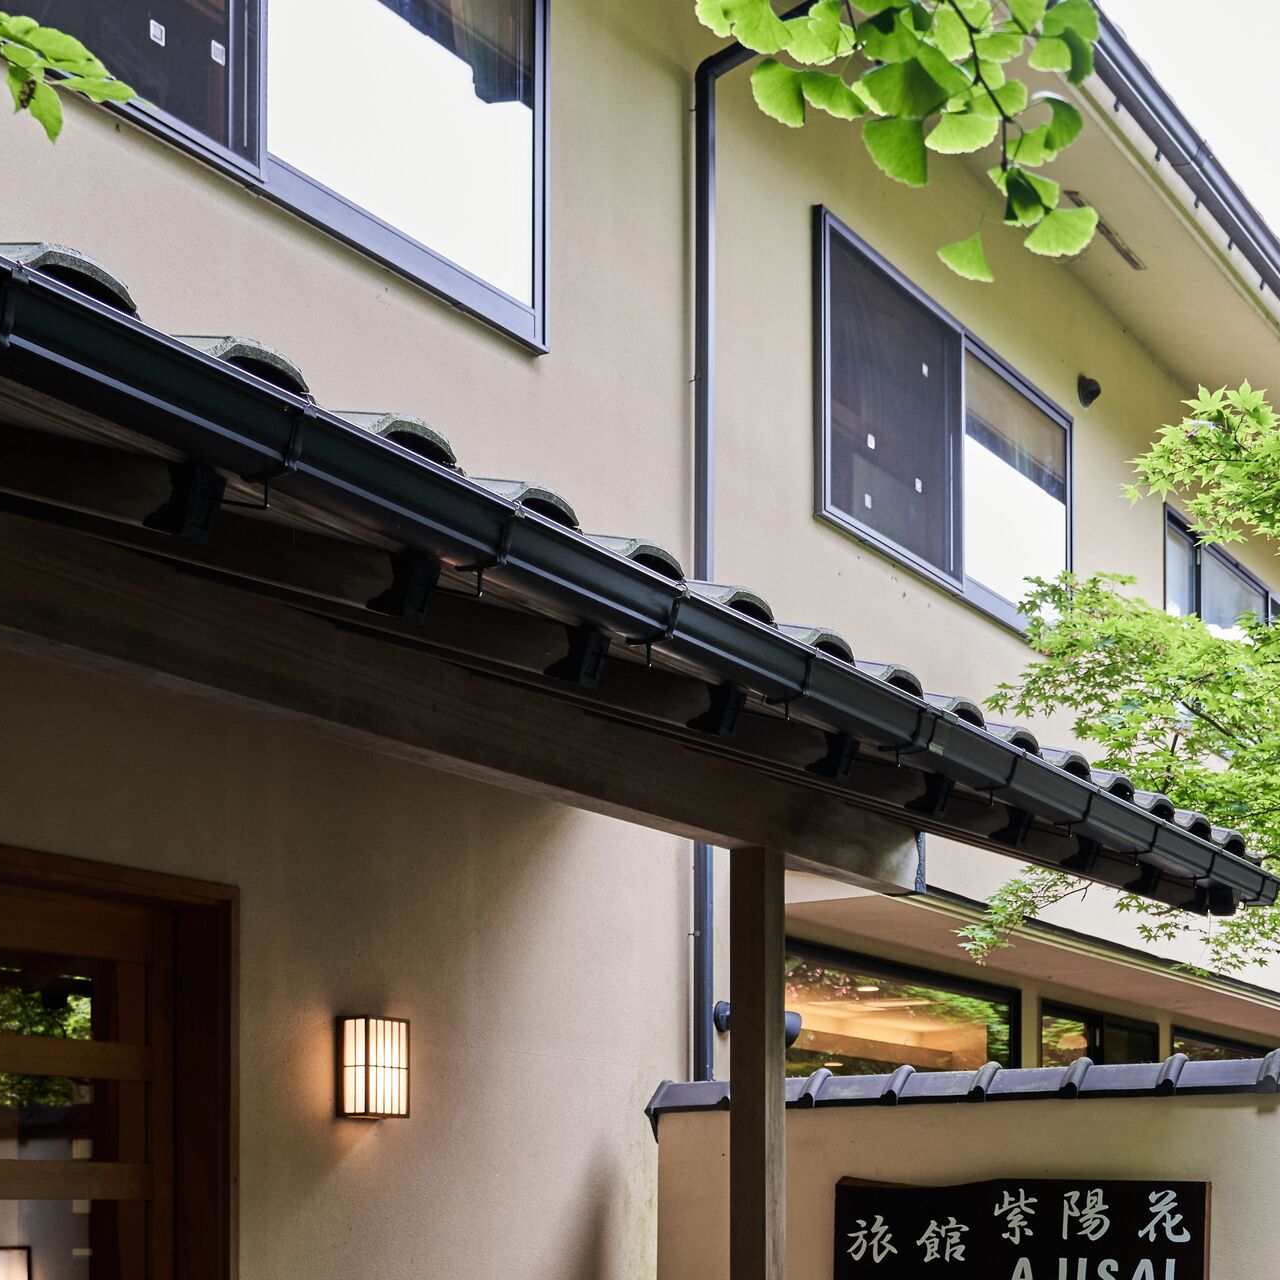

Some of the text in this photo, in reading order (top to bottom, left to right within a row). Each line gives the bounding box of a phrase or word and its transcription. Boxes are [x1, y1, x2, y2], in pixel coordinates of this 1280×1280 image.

[846, 1188, 1191, 1264] 旅館 紫陽花
